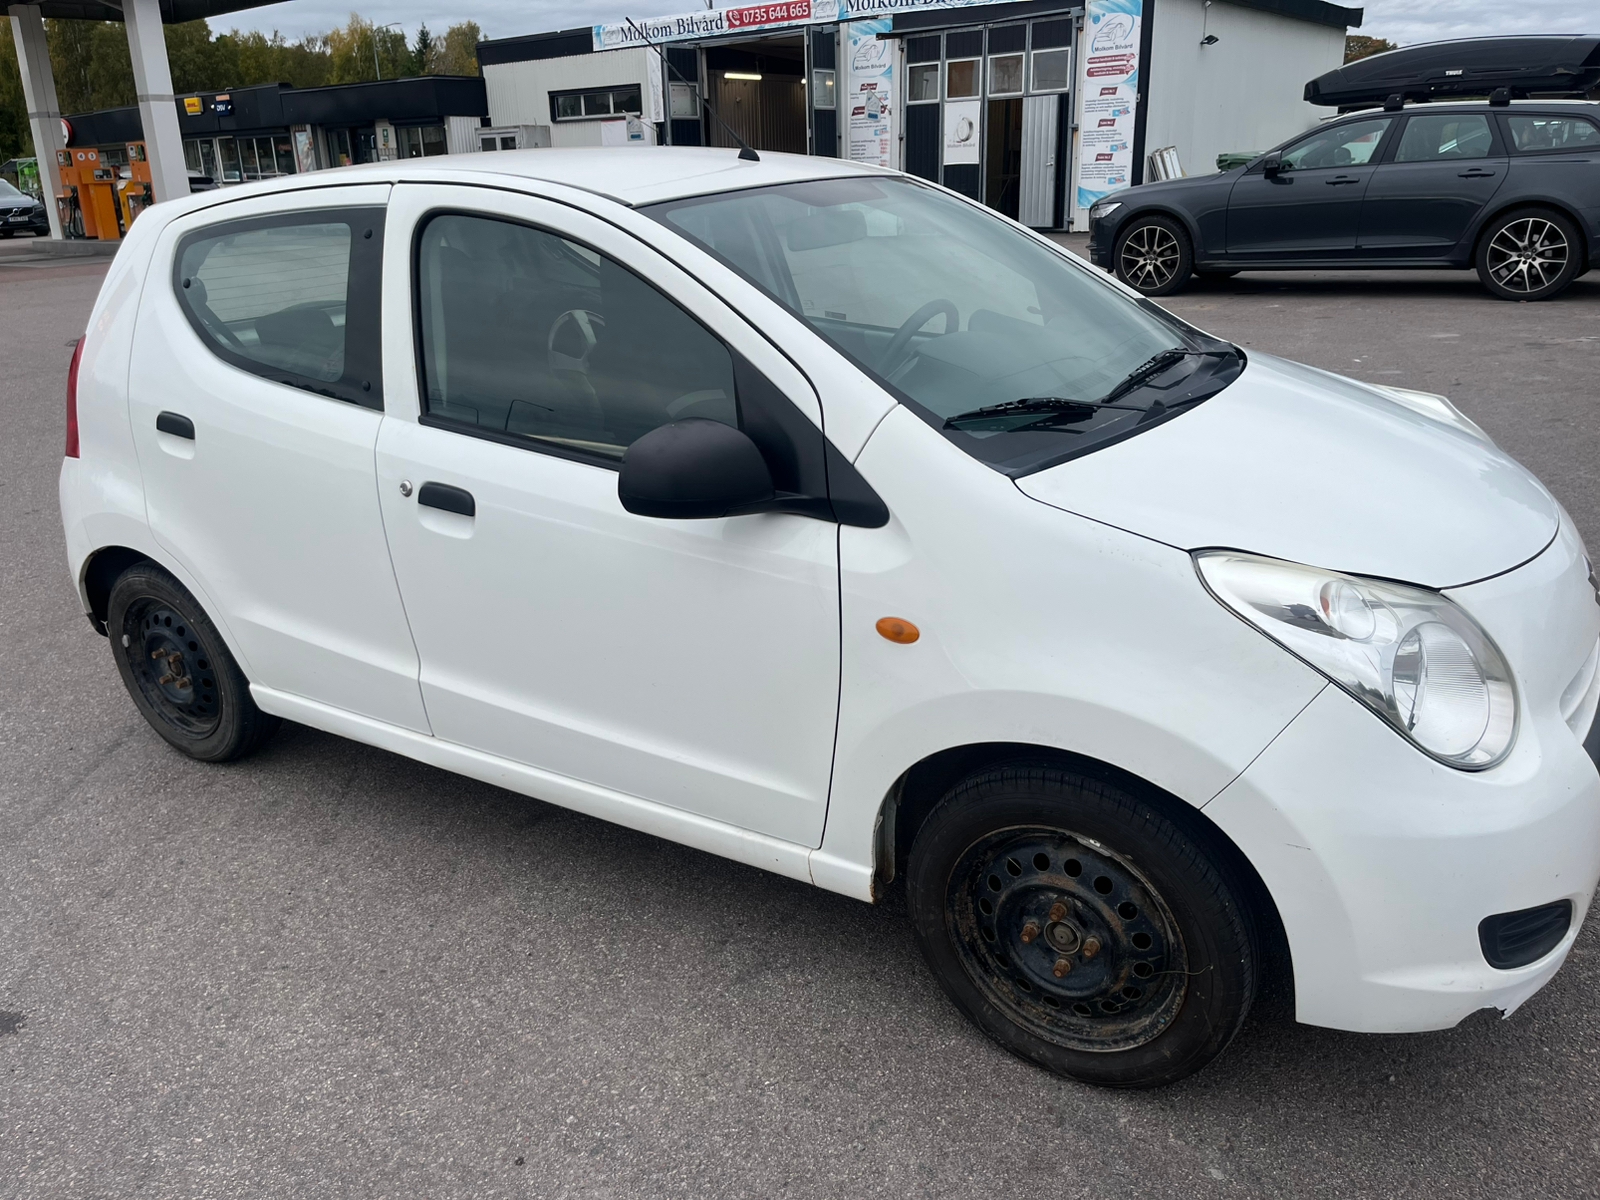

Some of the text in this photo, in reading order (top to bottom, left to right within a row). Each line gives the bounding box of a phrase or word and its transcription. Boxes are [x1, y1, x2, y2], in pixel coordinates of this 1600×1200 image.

[742, 2, 809, 23] 0735 644 665
[620, 12, 723, 43] Molkom Bilvård
